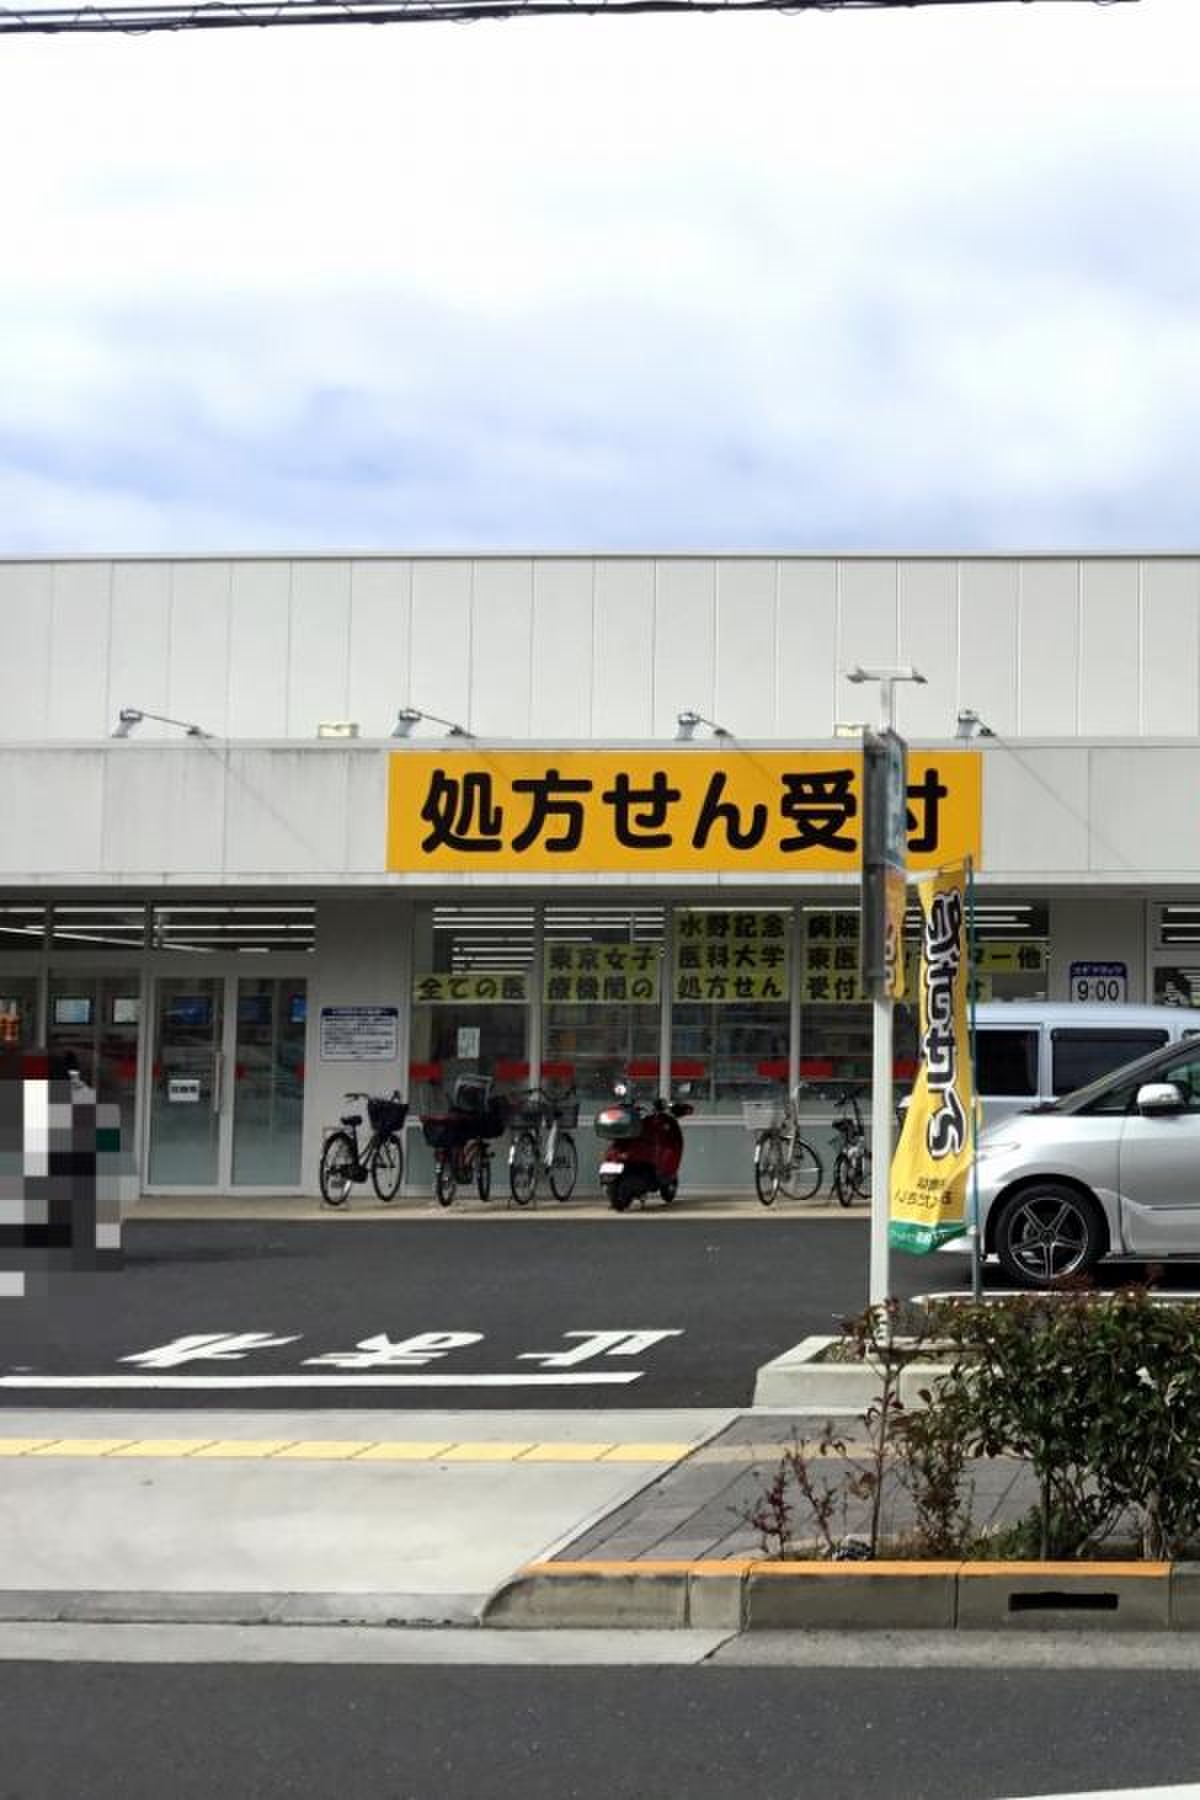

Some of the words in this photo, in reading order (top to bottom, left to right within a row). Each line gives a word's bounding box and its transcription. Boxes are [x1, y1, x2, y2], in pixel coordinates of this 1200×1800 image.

[420, 768, 948, 854] 処方せん受付
[1077, 979, 1121, 1002] 9:00
